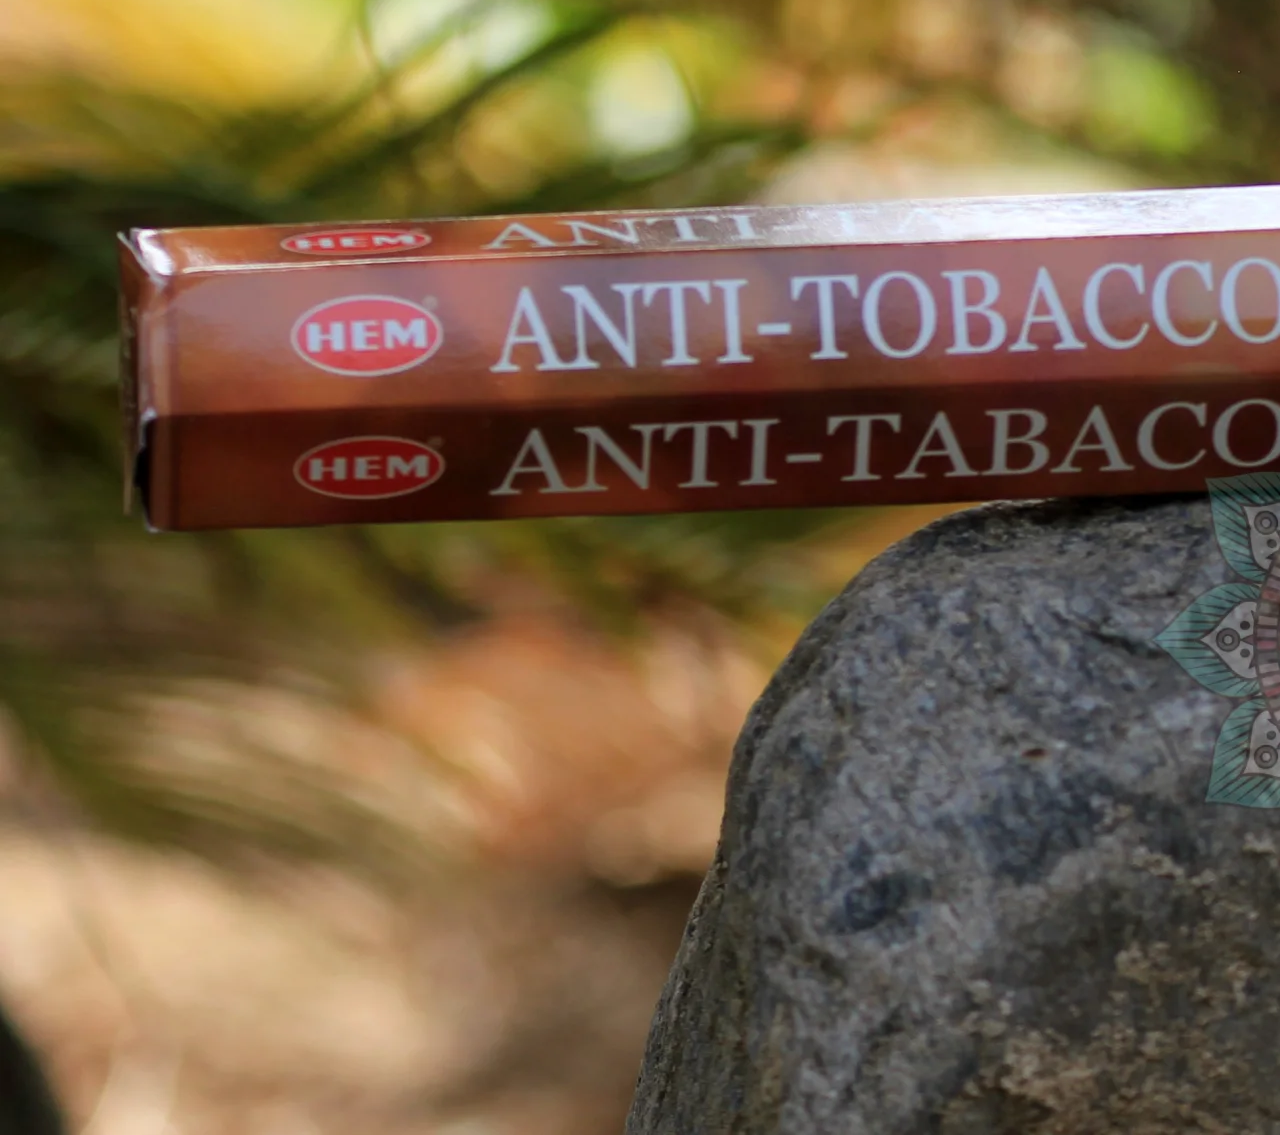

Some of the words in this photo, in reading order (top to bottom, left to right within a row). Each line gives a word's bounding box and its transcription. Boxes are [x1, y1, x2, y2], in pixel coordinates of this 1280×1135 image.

[296, 234, 416, 250] HEM
[306, 318, 428, 353] HEM
[308, 454, 430, 482] HEM
